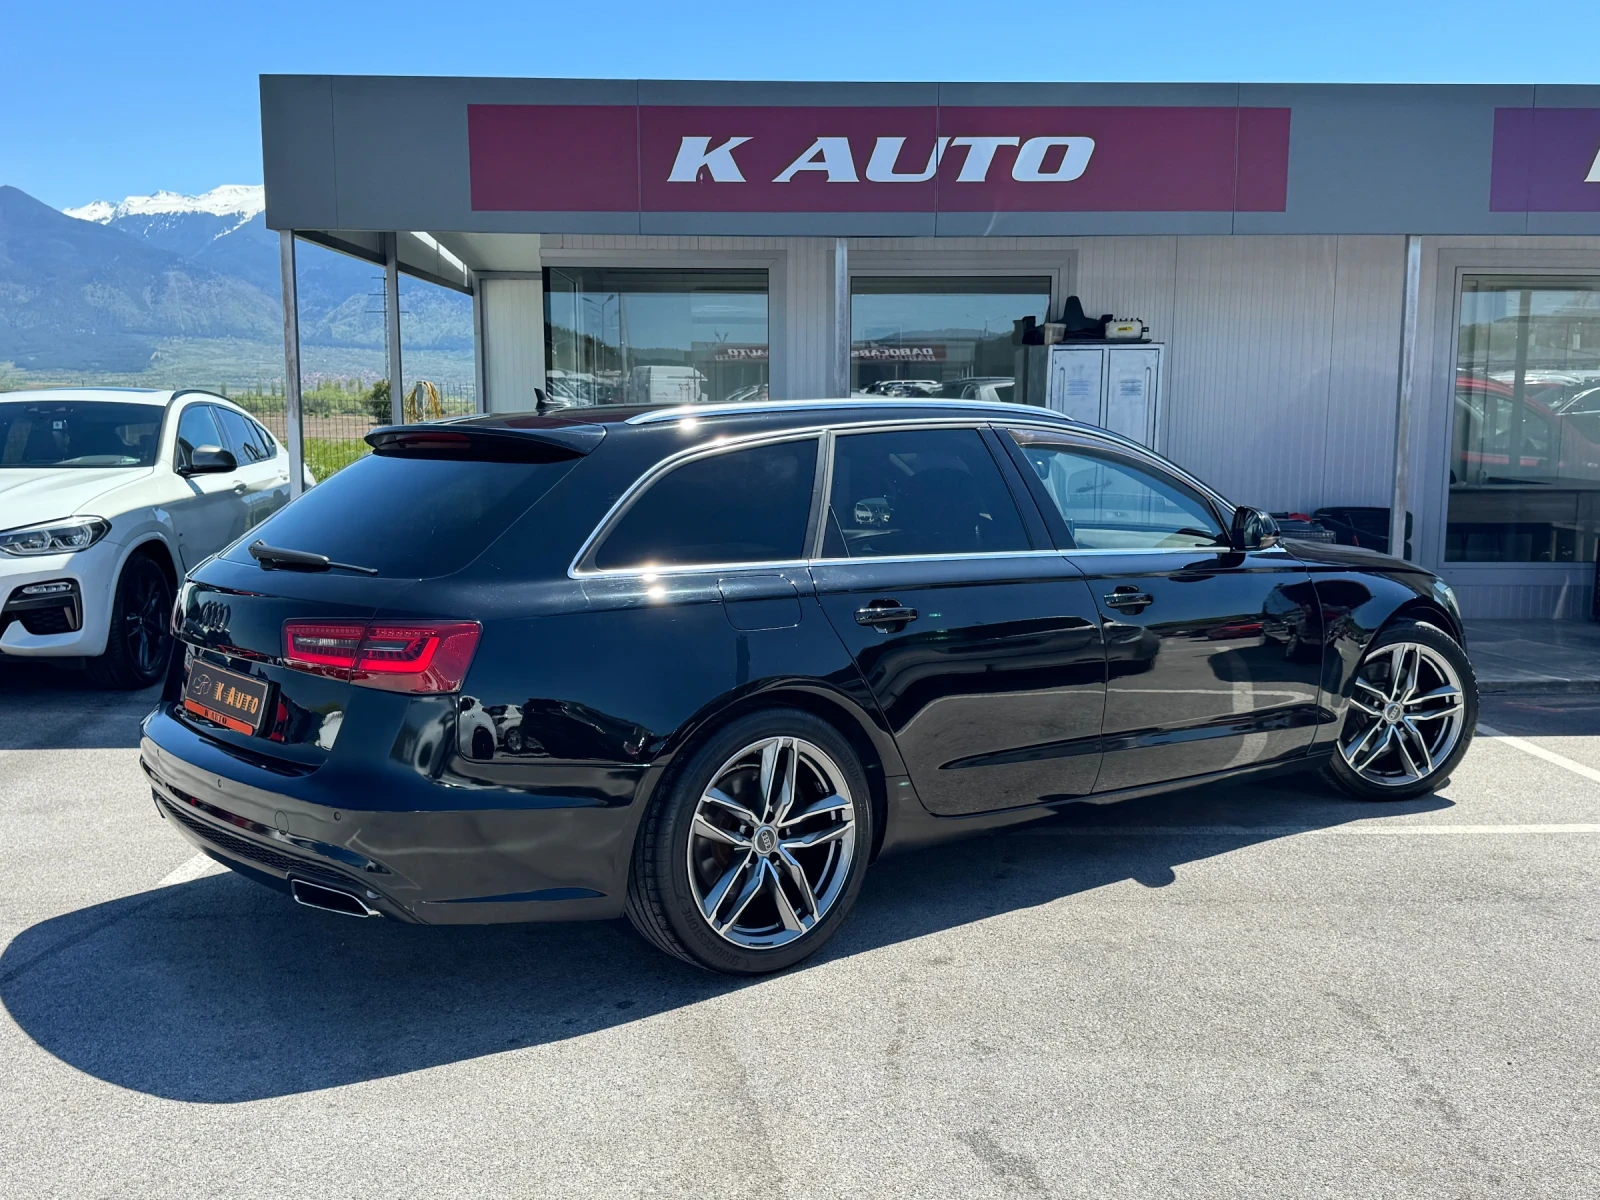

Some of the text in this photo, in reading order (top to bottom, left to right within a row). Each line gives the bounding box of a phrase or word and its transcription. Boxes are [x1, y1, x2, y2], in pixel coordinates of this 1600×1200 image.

[667, 136, 1095, 182] K AUTO
[215, 682, 225, 701] K
